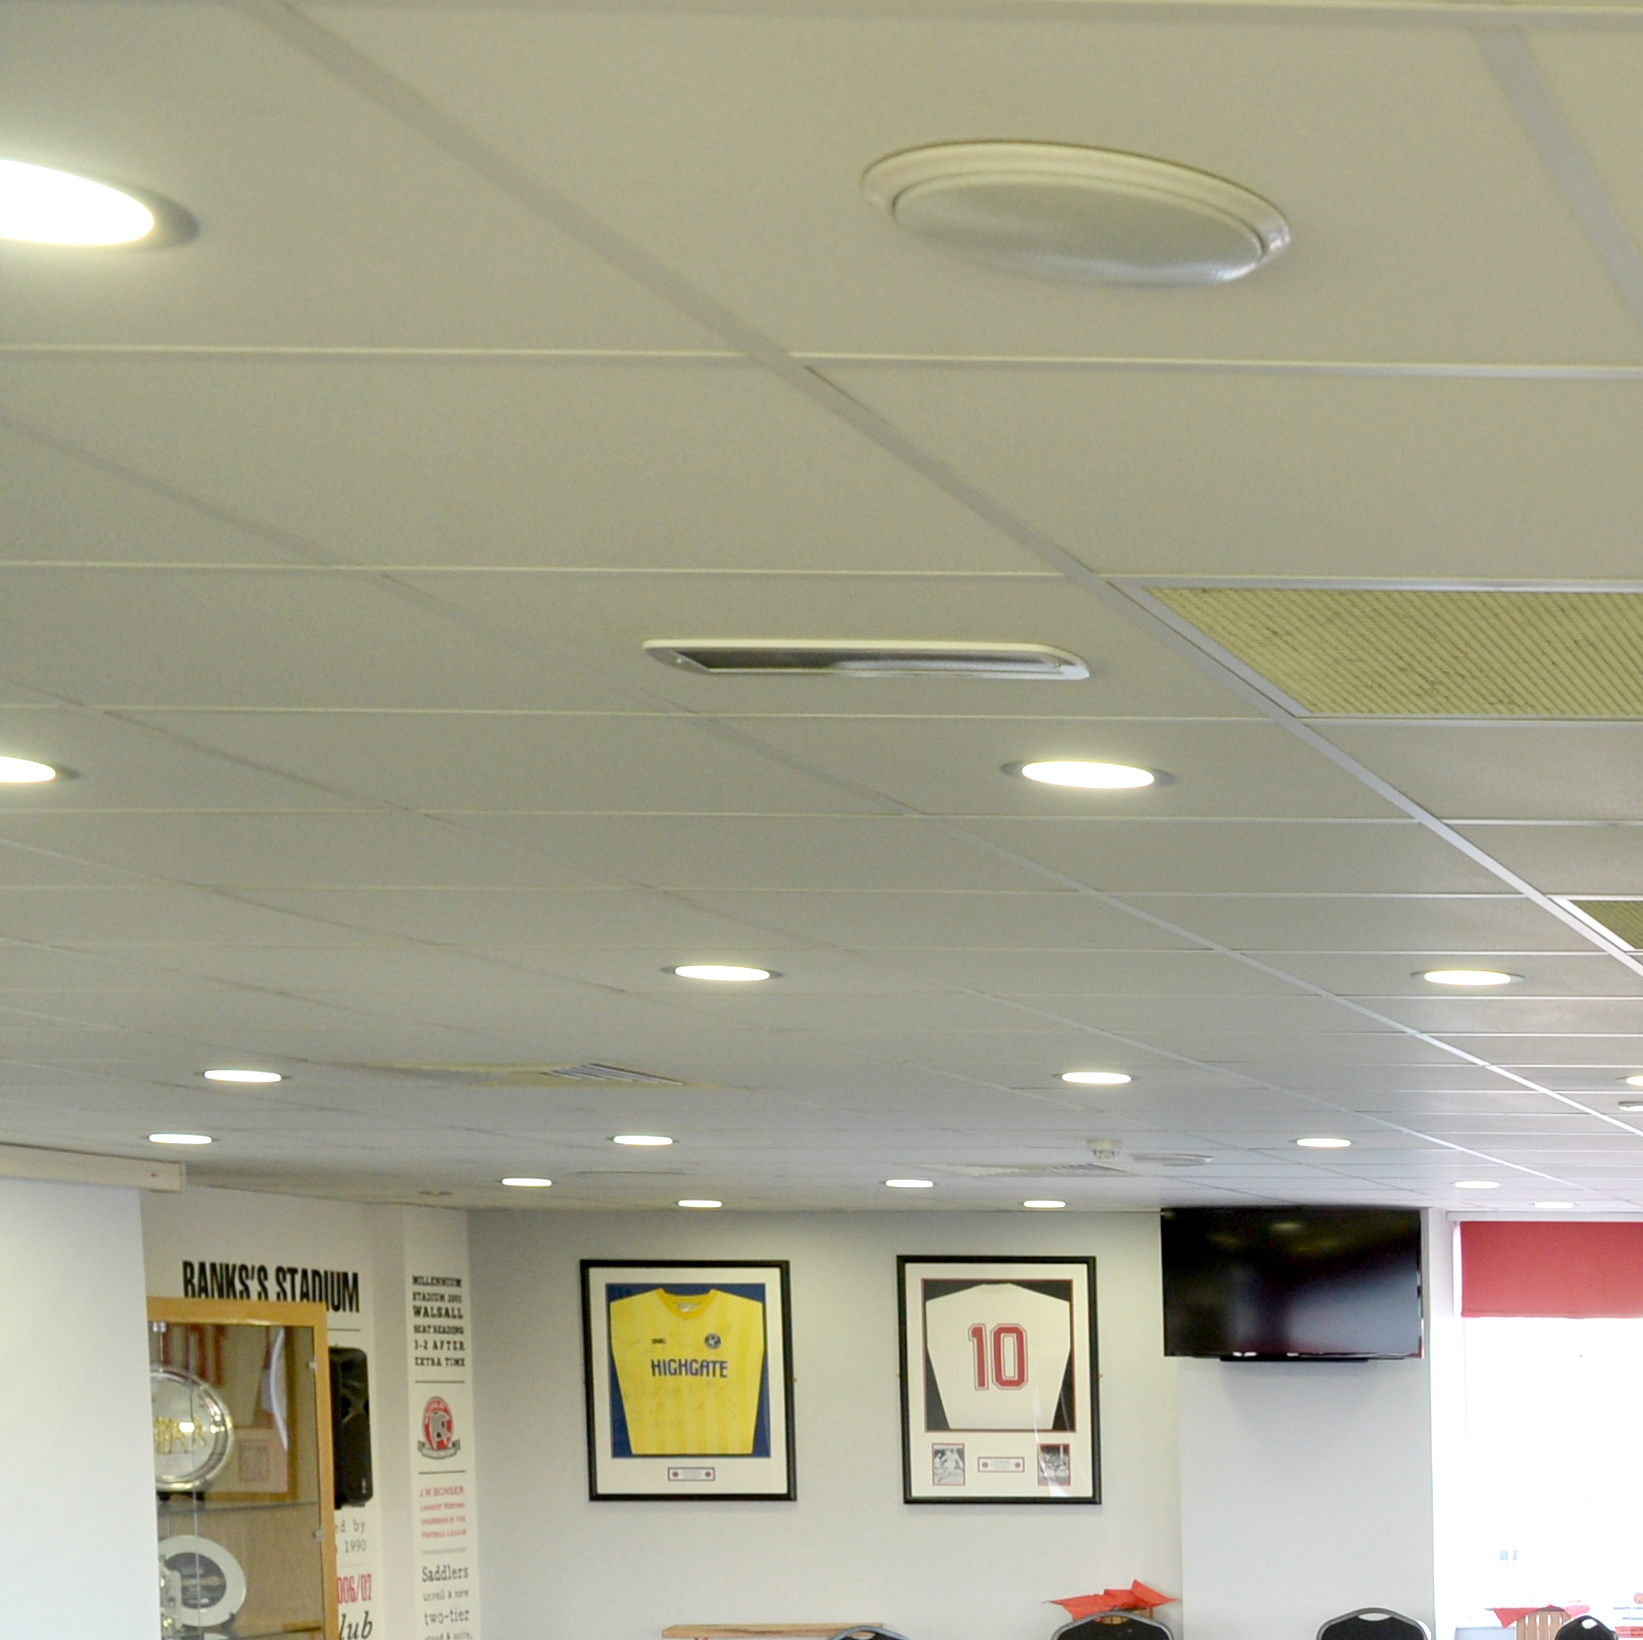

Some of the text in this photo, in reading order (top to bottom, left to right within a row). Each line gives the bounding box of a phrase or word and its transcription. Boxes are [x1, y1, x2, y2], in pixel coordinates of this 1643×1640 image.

[182, 1261, 360, 1313] BANKS'S STADIUM
[412, 1275, 462, 1288] MILLENNIUM
[412, 1291, 445, 1303] STADIUM
[412, 1305, 463, 1319] WALSALL
[413, 1324, 464, 1335] BEAT READING
[432, 1340, 465, 1351] AFTER
[414, 1356, 466, 1367] EXTRA TIME
[968, 1323, 1029, 1390] 10
[650, 1358, 728, 1378] HIGHGATE
[352, 1518, 366, 1534] by
[422, 1564, 469, 1583] Saddlers
[336, 1573, 372, 1604] 006/07
[424, 1607, 470, 1626] two-tier
